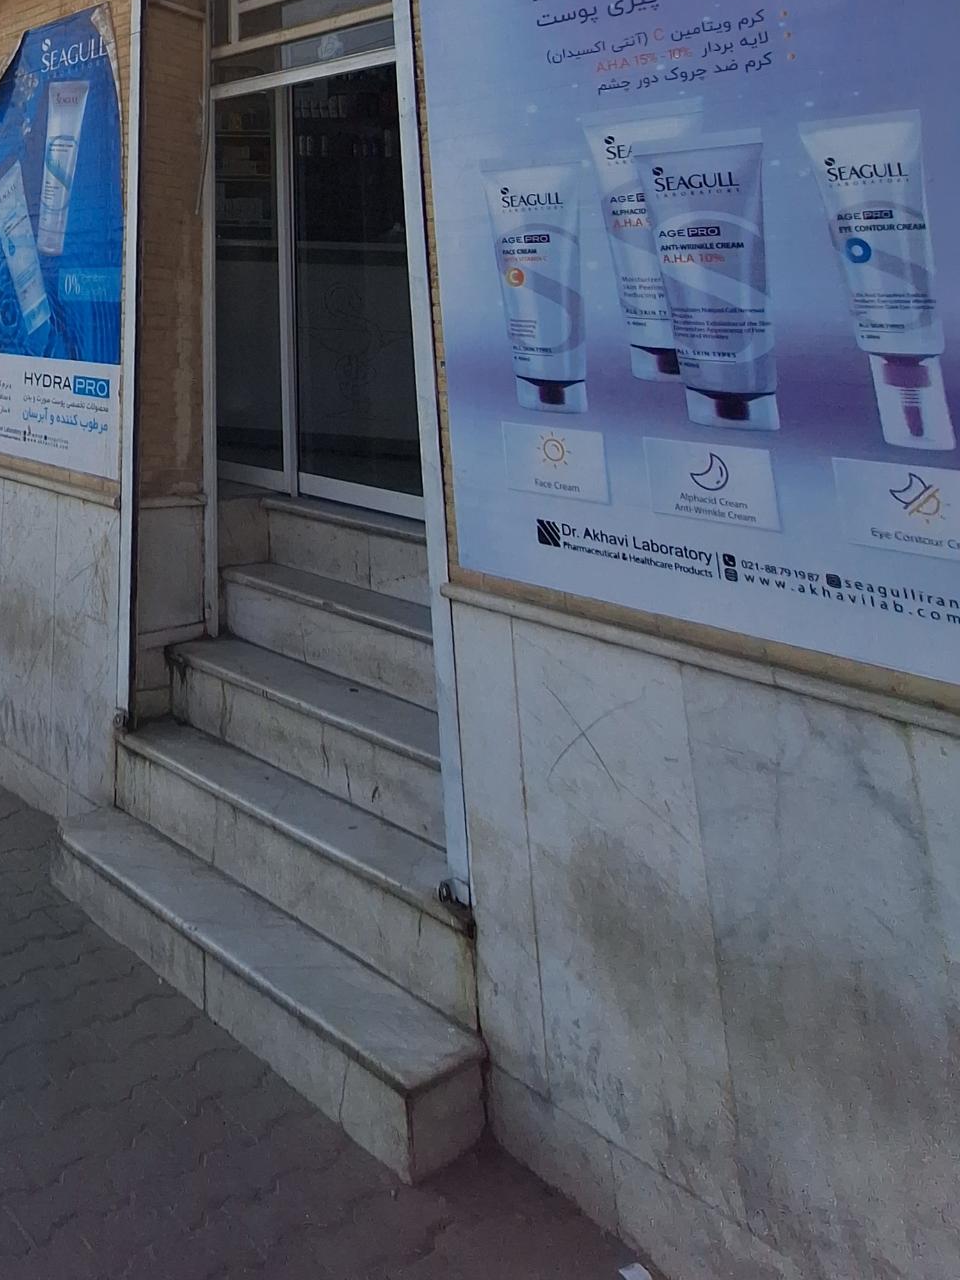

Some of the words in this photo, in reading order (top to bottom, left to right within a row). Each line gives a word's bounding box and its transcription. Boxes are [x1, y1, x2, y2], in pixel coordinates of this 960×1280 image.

[536, 4, 598, 28] پوست
[738, 8, 765, 31] کرم
[670, 19, 732, 43] ویتامین
[739, 31, 769, 49] لایه
[41, 36, 107, 73] SEAGULL
[701, 39, 735, 59] بردار
[713, 58, 739, 76] ضد
[745, 51, 772, 75] کرم
[637, 73, 659, 90] دور
[664, 66, 707, 83] چروک
[597, 77, 631, 95] چشم
[827, 162, 909, 183] SEAGULL
[654, 171, 739, 193] SEAGULL
[501, 191, 564, 209] SEAGULL
[502, 236, 524, 244] AGE
[659, 228, 686, 238] AGE
[689, 227, 719, 236] PRO
[24, 372, 72, 391] HYDRA
[75, 378, 108, 397] PRO
[56, 413, 78, 426] کننده
[80, 417, 109, 434] مرطوب
[534, 478, 552, 489] Face
[554, 481, 580, 493] Cream
[680, 492, 717, 506] Alphacid
[719, 497, 748, 510] Cream
[728, 510, 757, 523] Cream
[562, 523, 580, 538] Dr.
[583, 527, 629, 548] Akhavi
[633, 536, 712, 566] Laboratory
[563, 541, 621, 561] Pharmaceutical
[629, 554, 674, 571] Healthcare
[674, 562, 713, 579] Products
